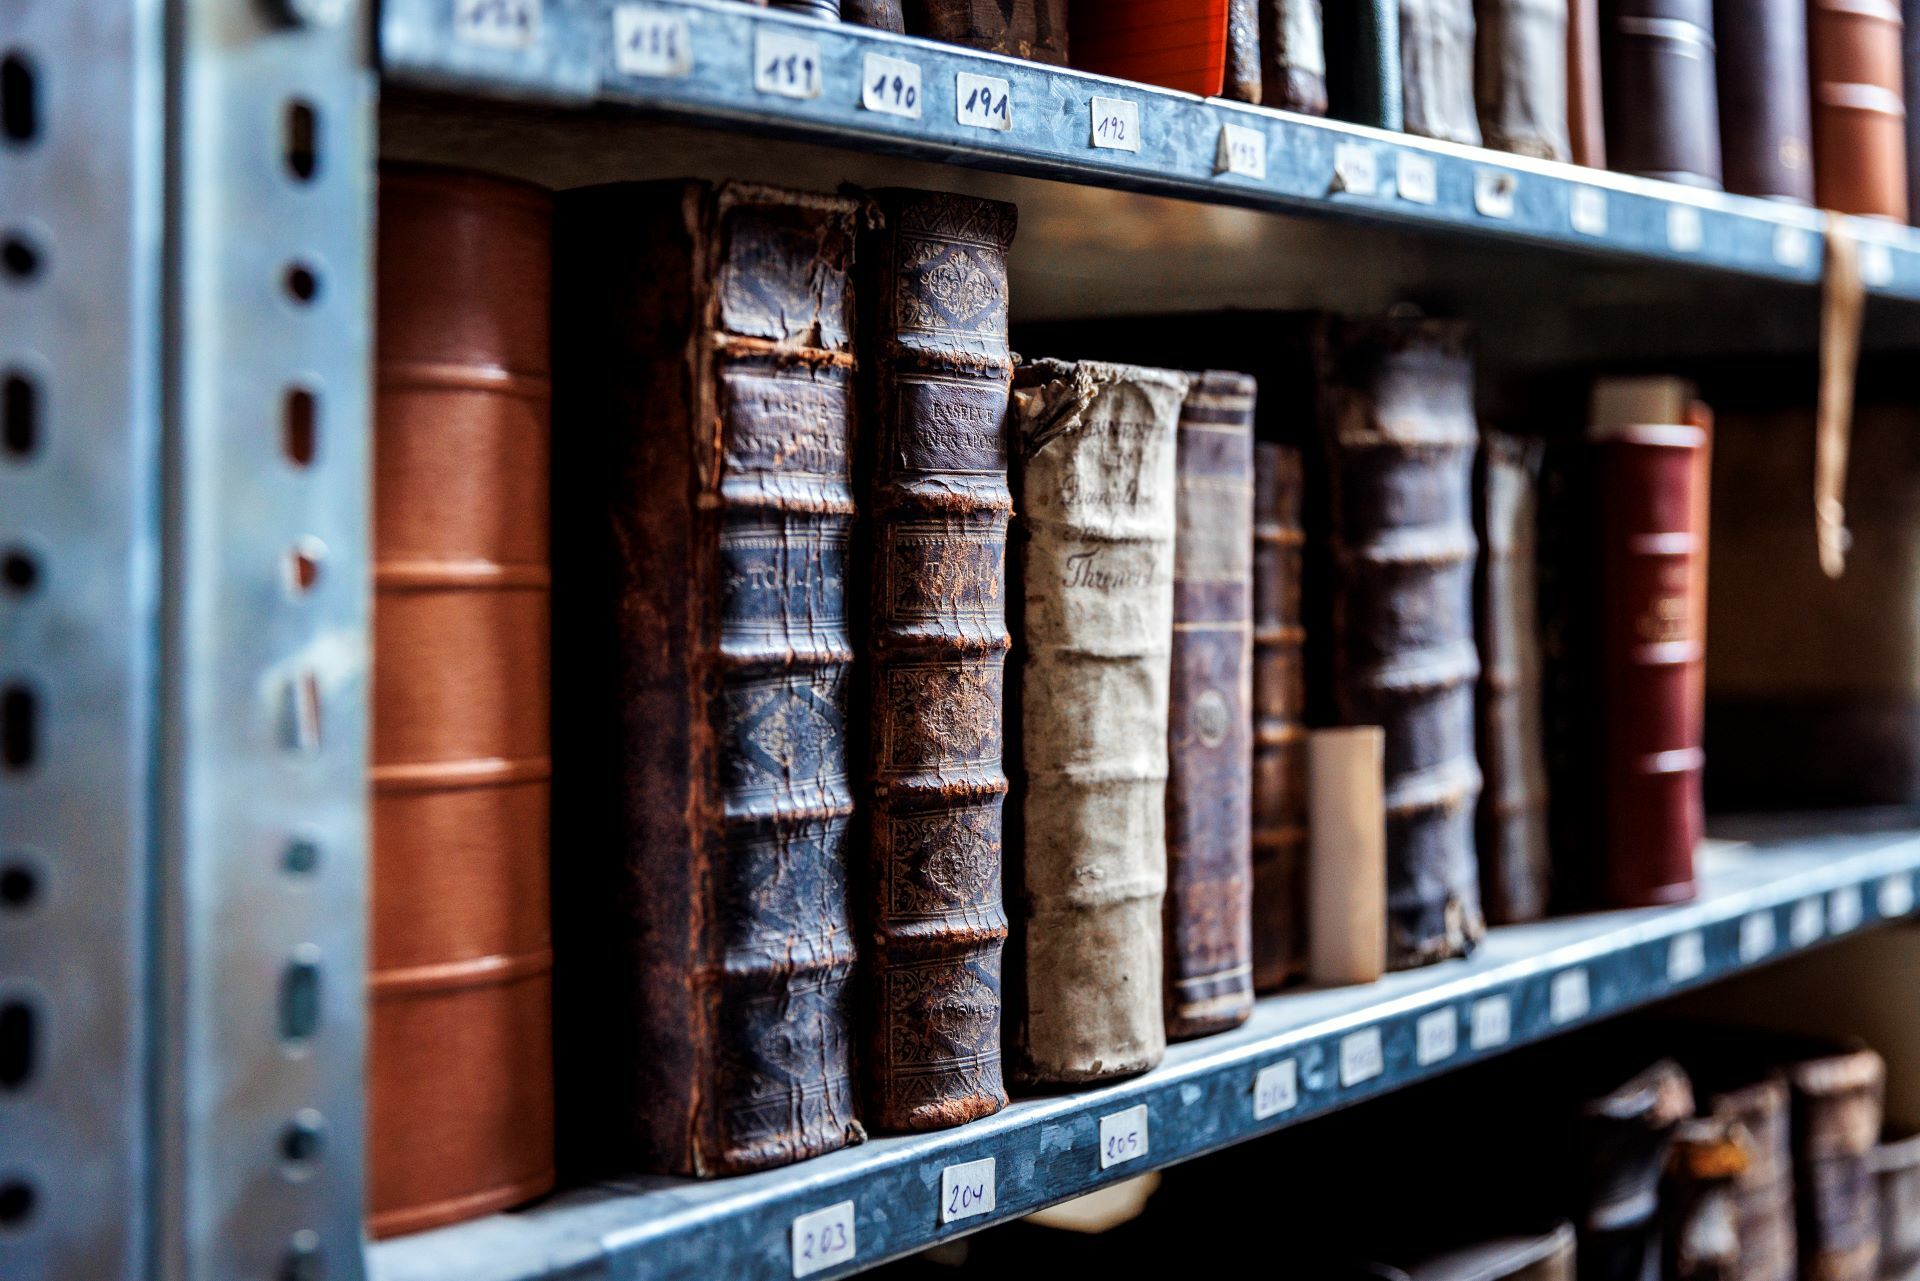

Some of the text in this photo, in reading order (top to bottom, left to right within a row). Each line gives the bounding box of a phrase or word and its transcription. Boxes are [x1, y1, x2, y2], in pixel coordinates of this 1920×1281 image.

[765, 53, 814, 90] 189
[873, 74, 916, 108] 190
[965, 87, 1008, 120] 191
[1097, 116, 1125, 141] 192
[1107, 1132, 1139, 1159] 205
[947, 1184, 984, 1214] 204
[802, 1223, 848, 1260] 203
